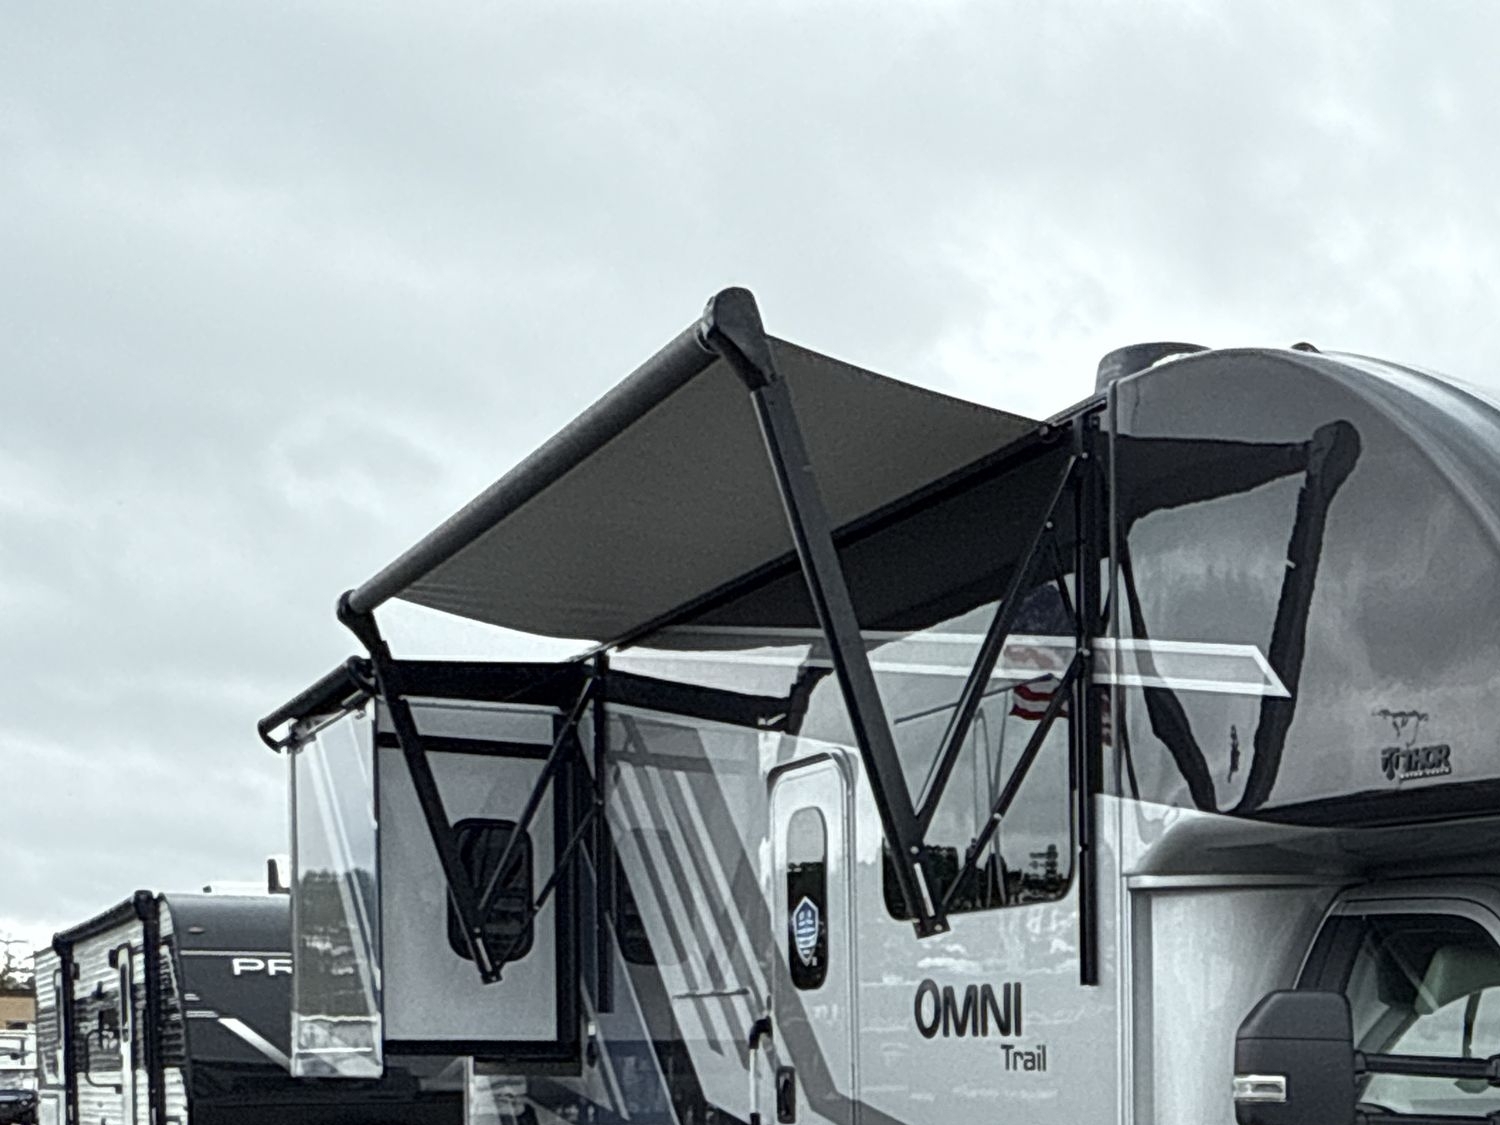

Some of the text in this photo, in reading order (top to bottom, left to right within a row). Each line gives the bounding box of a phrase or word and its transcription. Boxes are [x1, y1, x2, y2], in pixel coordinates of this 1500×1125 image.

[232, 957, 294, 976] PR
[914, 978, 1022, 1039] OMNI
[1001, 1044, 1047, 1072] Trail
